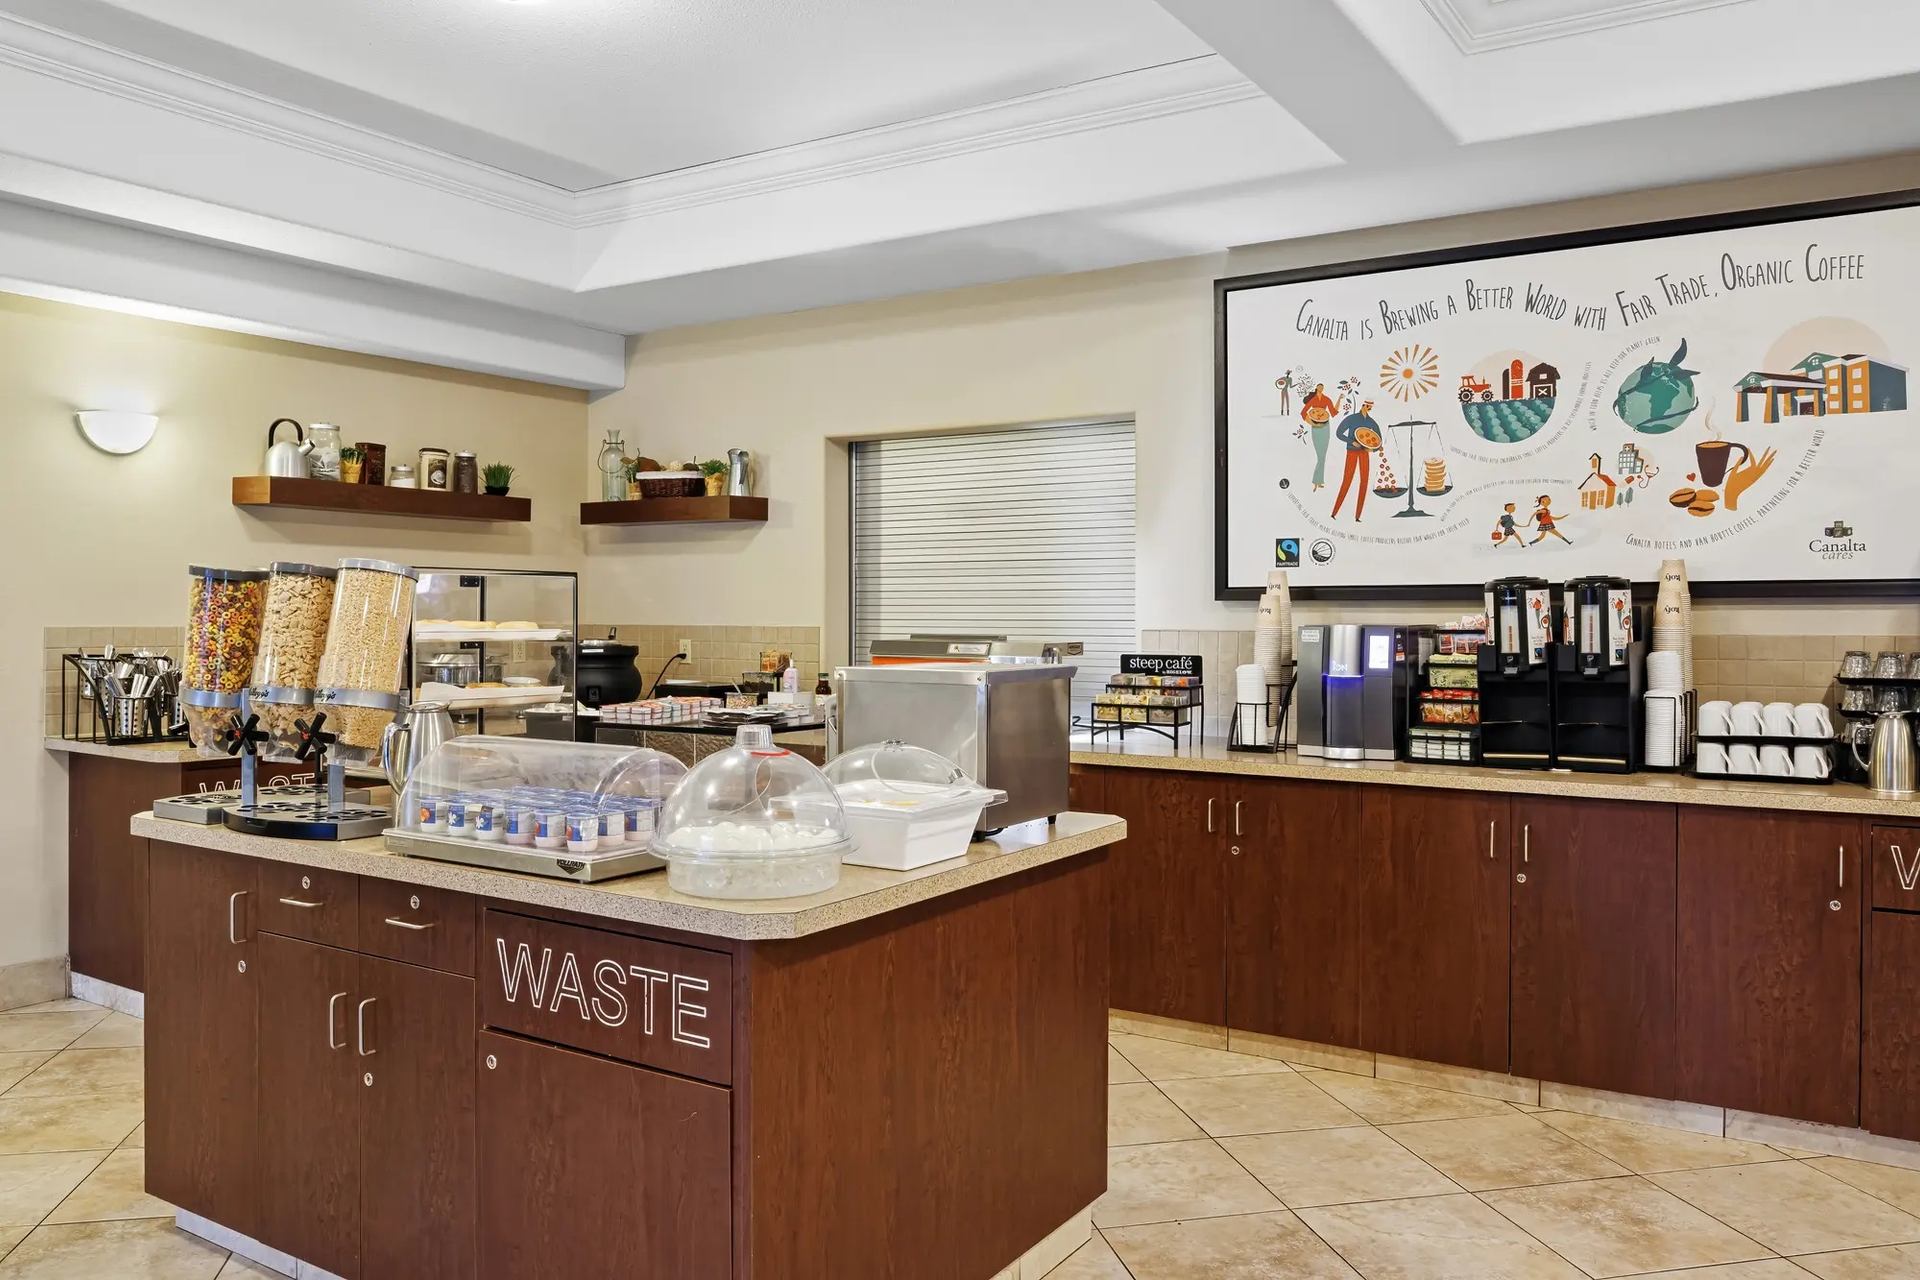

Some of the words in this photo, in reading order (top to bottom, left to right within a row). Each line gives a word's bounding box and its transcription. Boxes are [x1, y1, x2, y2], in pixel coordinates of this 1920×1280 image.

[1296, 298, 1348, 341] CANALTA
[1360, 318, 1374, 341] IS
[1379, 299, 1439, 336] BREWING
[1447, 294, 1458, 316] A
[1465, 278, 1514, 312] BETTER
[1524, 281, 1568, 321] WORLD
[1573, 304, 1607, 331] WITH
[1615, 290, 1657, 327] FAIR
[1720, 252, 1794, 291] ORGANIC
[1804, 243, 1866, 283] COFFEE
[1808, 538, 1867, 552] Canalta
[1821, 551, 1854, 560] cares
[1129, 656, 1164, 673] steep
[1165, 656, 1193, 670] café
[497, 938, 710, 1048] WASTE
